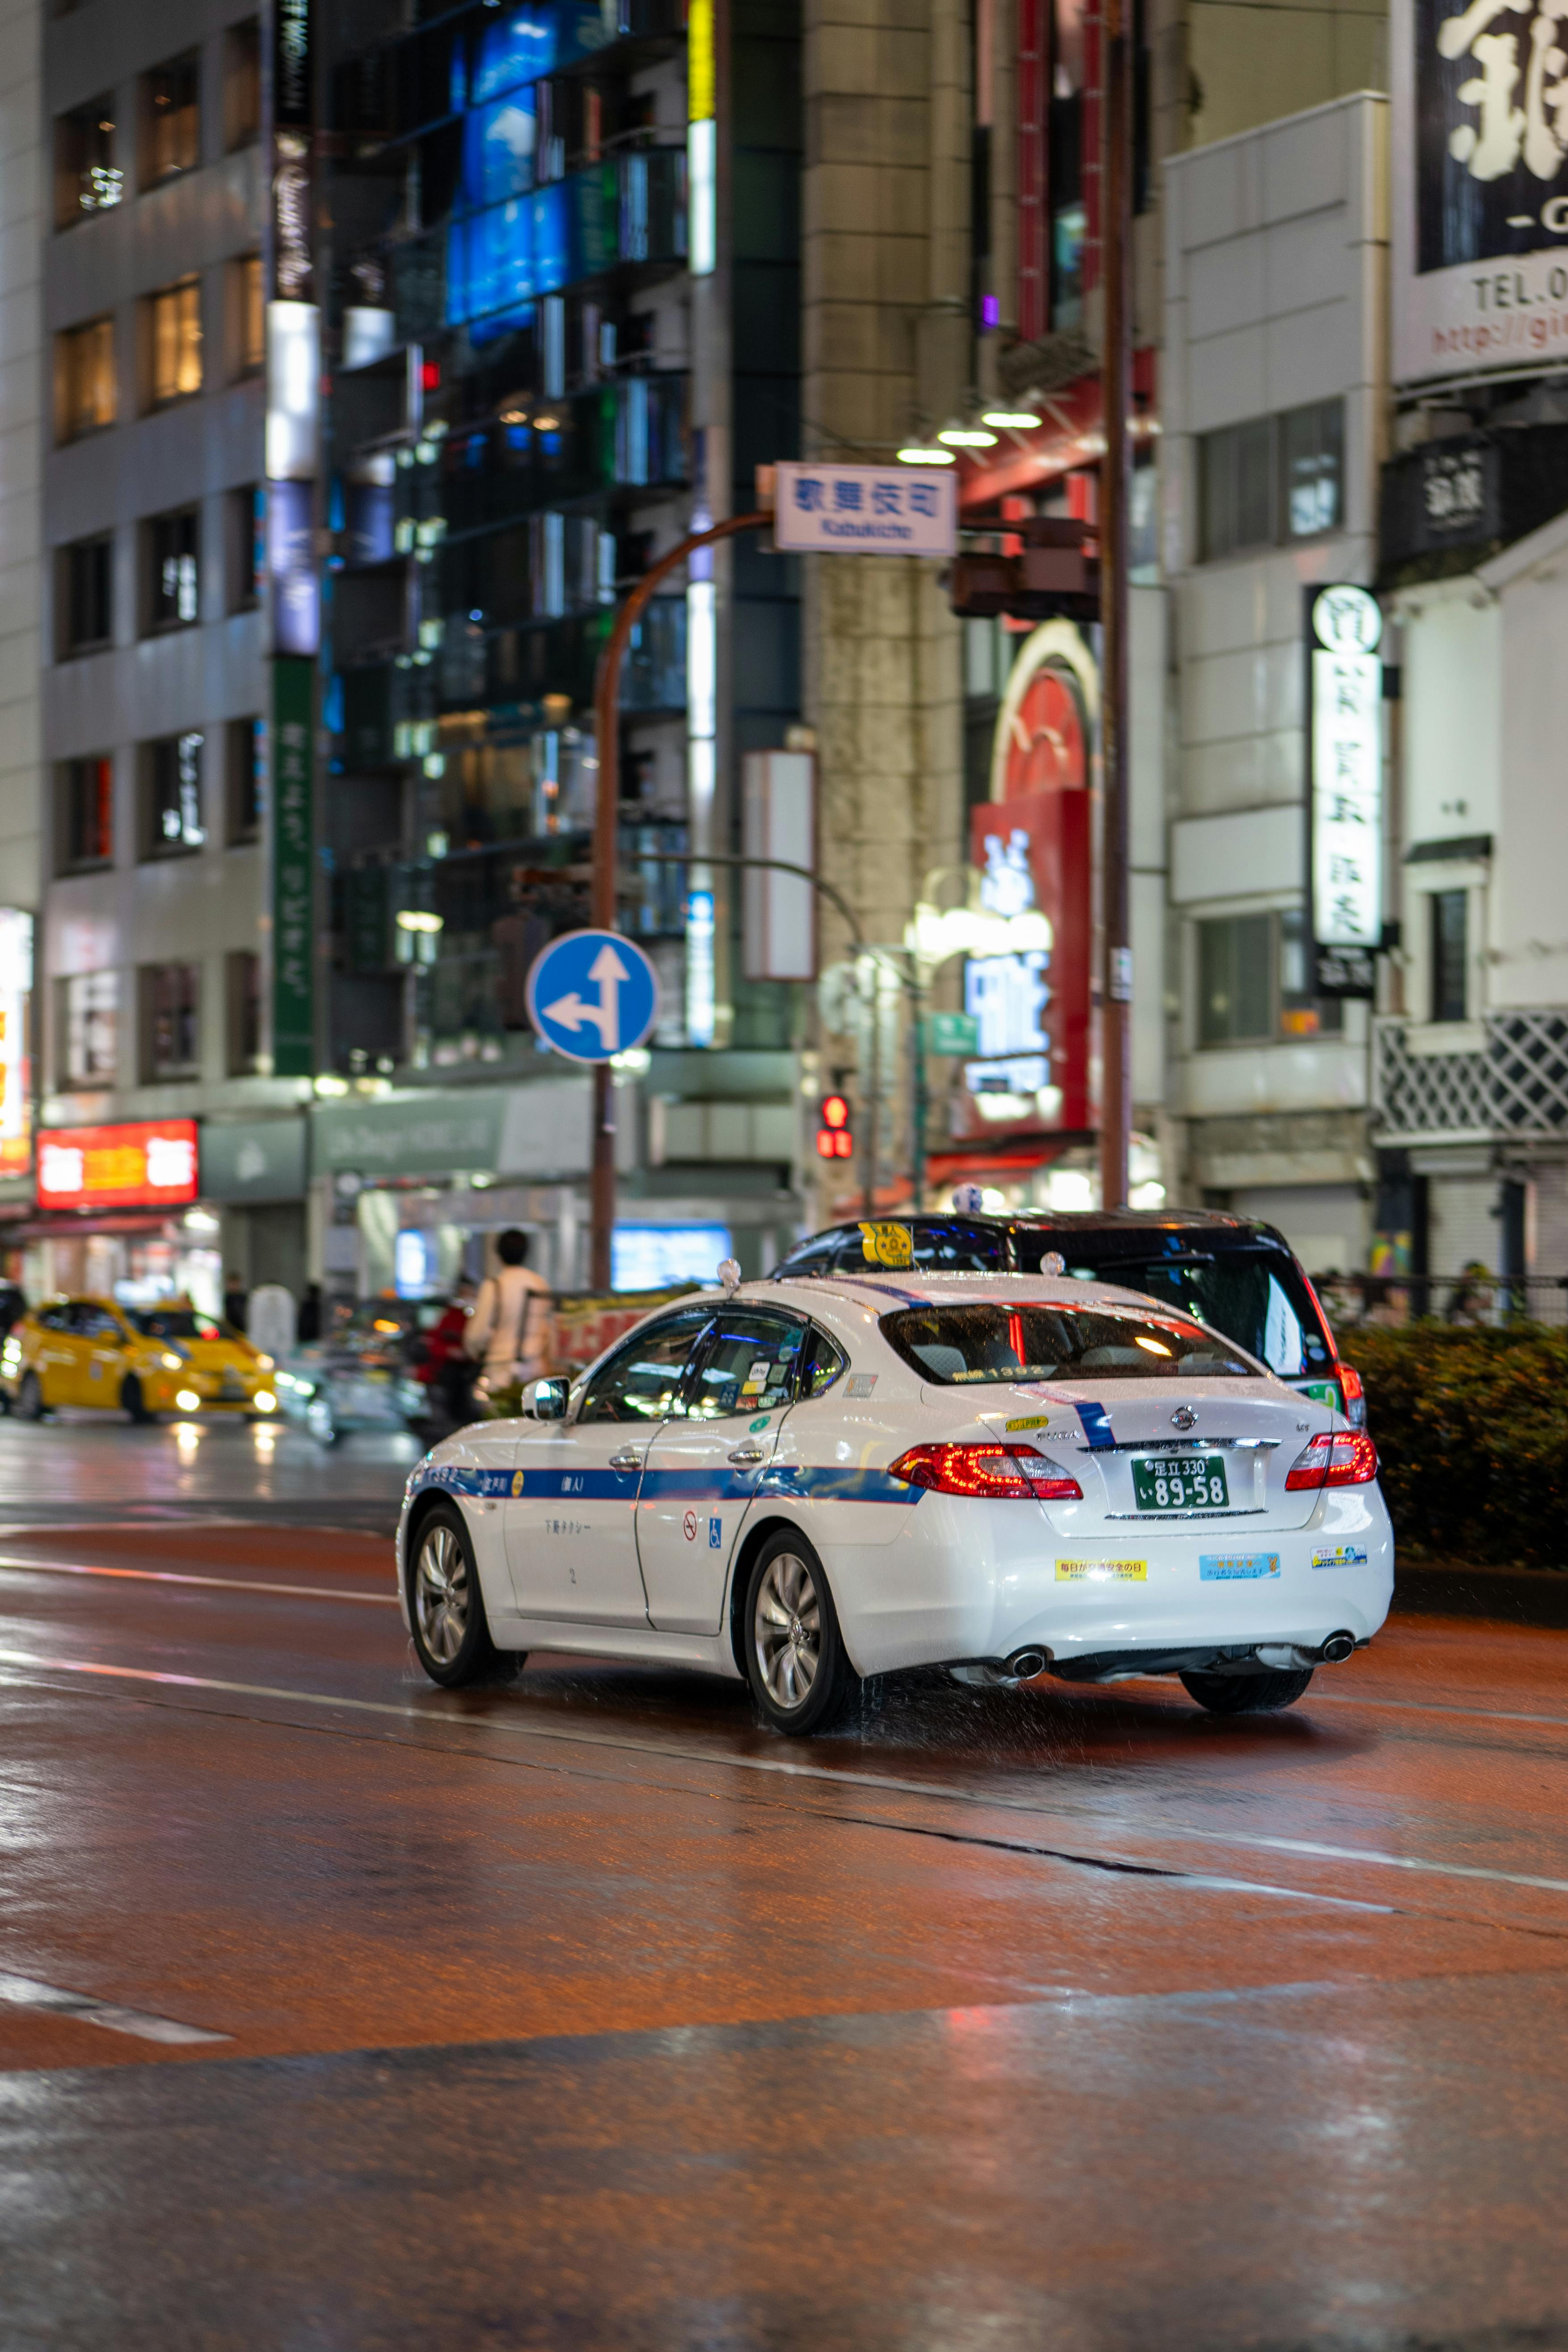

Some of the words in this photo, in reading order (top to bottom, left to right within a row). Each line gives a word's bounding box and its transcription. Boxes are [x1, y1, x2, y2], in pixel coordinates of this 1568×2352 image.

[1036, 1429, 1081, 1442] FUGA
[1154, 1461, 1181, 1477] 足立
[1182, 1459, 1206, 1475] 330
[1154, 1475, 1224, 1507] 89-58
